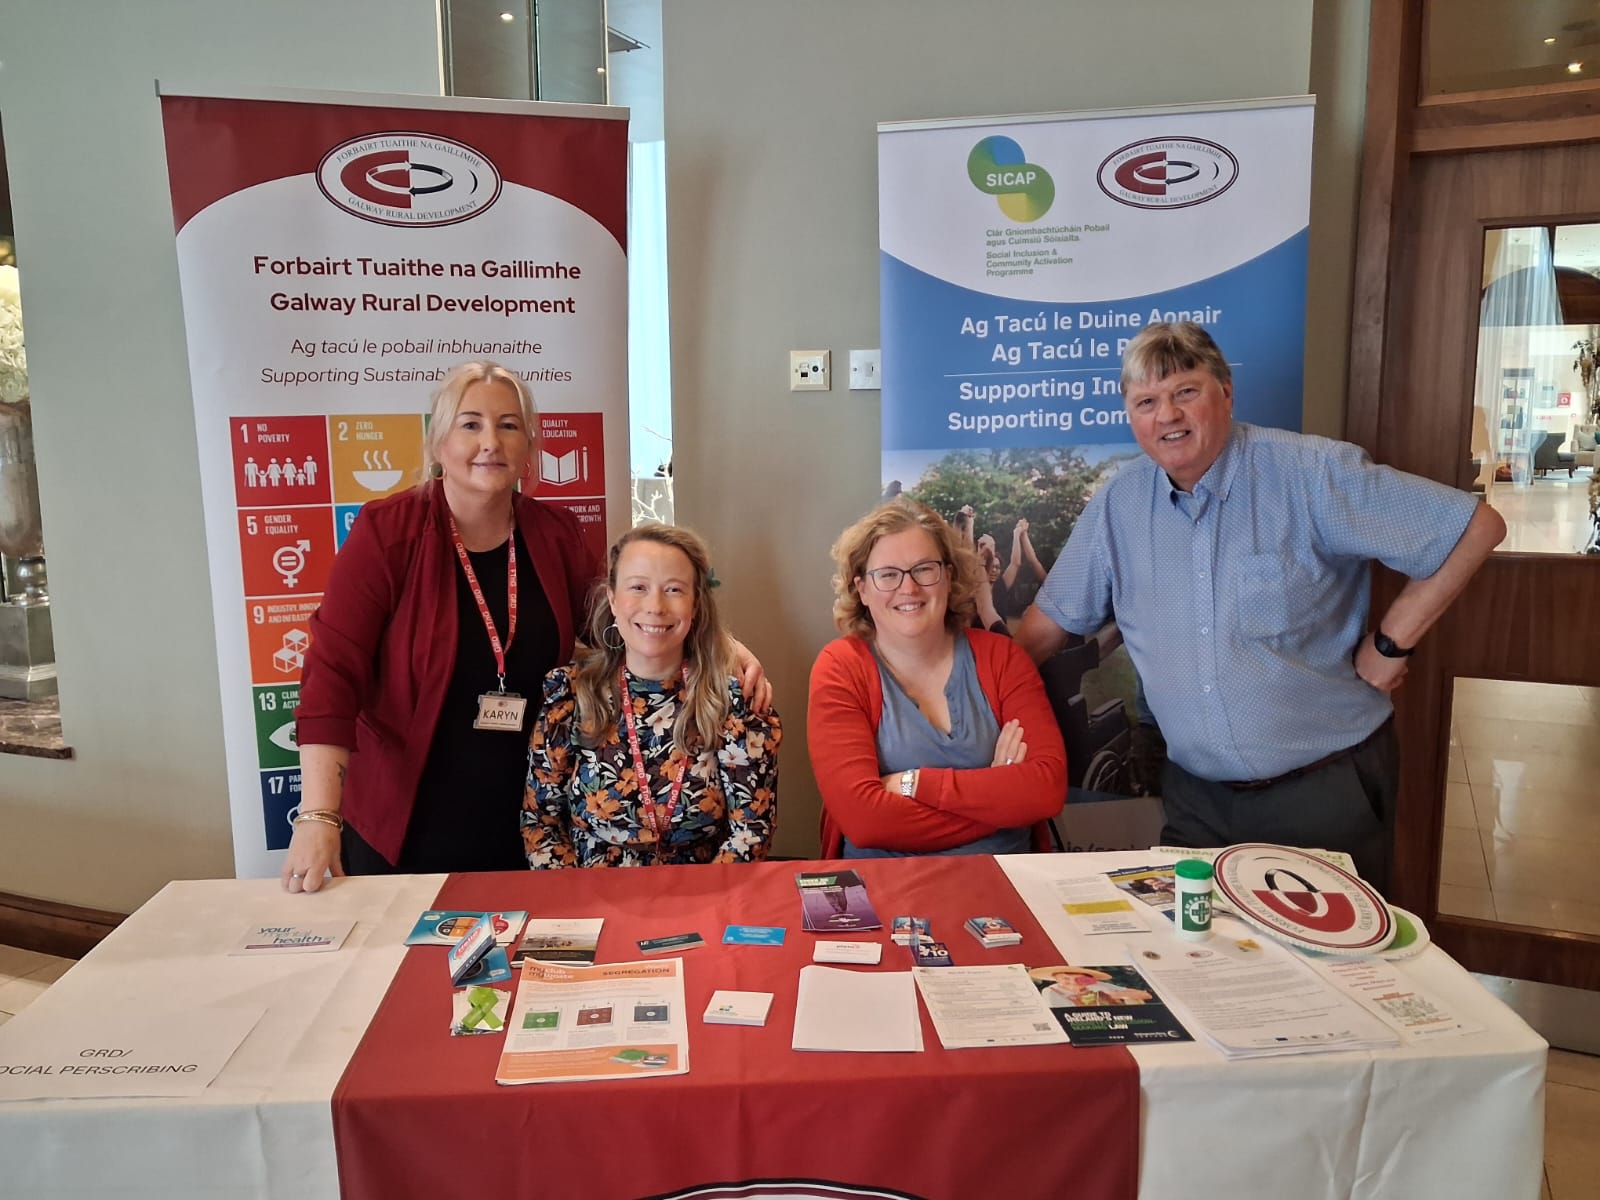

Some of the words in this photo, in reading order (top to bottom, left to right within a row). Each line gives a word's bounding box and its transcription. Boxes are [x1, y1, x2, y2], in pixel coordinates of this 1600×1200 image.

[336, 141, 378, 164] FORBAIRT
[380, 139, 418, 148] TUAITHE
[420, 140, 432, 149] NA
[434, 142, 482, 169] GAILLIMHE
[985, 171, 1036, 187] SICAP
[348, 196, 388, 216] GALWAY
[385, 208, 416, 220] RURAL
[416, 200, 478, 220] DEVELOPMENT
[1084, 223, 1110, 232] Pobail
[986, 238, 1006, 247] agus
[986, 250, 1011, 259] Social
[1013, 249, 1050, 258] Inclusion
[253, 255, 353, 277] Forbairt
[356, 257, 444, 277] Tuaithe
[450, 263, 476, 277] na
[481, 258, 582, 280] Gaillimhe
[986, 259, 1032, 268] Community
[1033, 257, 1073, 266] Activation
[986, 267, 1034, 277] Programme
[270, 292, 356, 316] Galway
[362, 293, 421, 312] Rural
[426, 294, 576, 318] Development
[961, 317, 989, 338] Ag
[994, 311, 1047, 333] Tacú
[1054, 311, 1072, 331] le
[1079, 309, 1141, 329] Duine
[290, 338, 316, 359] Ag
[321, 337, 359, 355] tacú
[363, 338, 377, 354] le
[381, 338, 434, 358] pobail
[436, 338, 542, 355] inbhuanaithe
[992, 343, 1021, 364] Ag
[1028, 337, 1083, 359] Tacú
[1090, 338, 1110, 358] le
[261, 367, 359, 387] Supporting
[362, 367, 448, 383] Sustainab
[959, 377, 1085, 403] Supporting
[542, 419, 568, 428] QUALITY
[948, 409, 1073, 433] Supporting
[240, 423, 249, 444] 1
[257, 423, 268, 432] NO
[257, 433, 290, 443] POVERTY
[338, 421, 348, 441] 2
[356, 421, 373, 431] ZERO
[356, 431, 384, 441] HUNGER
[542, 429, 577, 438] EDUCATION
[588, 504, 600, 512] AND
[246, 515, 258, 535] 5
[264, 514, 292, 524] GENDER
[576, 514, 602, 523] ROWTH
[265, 524, 298, 535] EQUALITY
[253, 605, 264, 624] 9
[258, 691, 277, 711] 13
[482, 709, 519, 721] KARYN
[268, 775, 284, 795] 17
[257, 927, 295, 935] your
[602, 967, 670, 976] SEGREGATION
[78, 1048, 134, 1059] GRD/
[0, 1065, 53, 1075] OCIAL
[59, 1064, 198, 1075] PERSCRIBING
